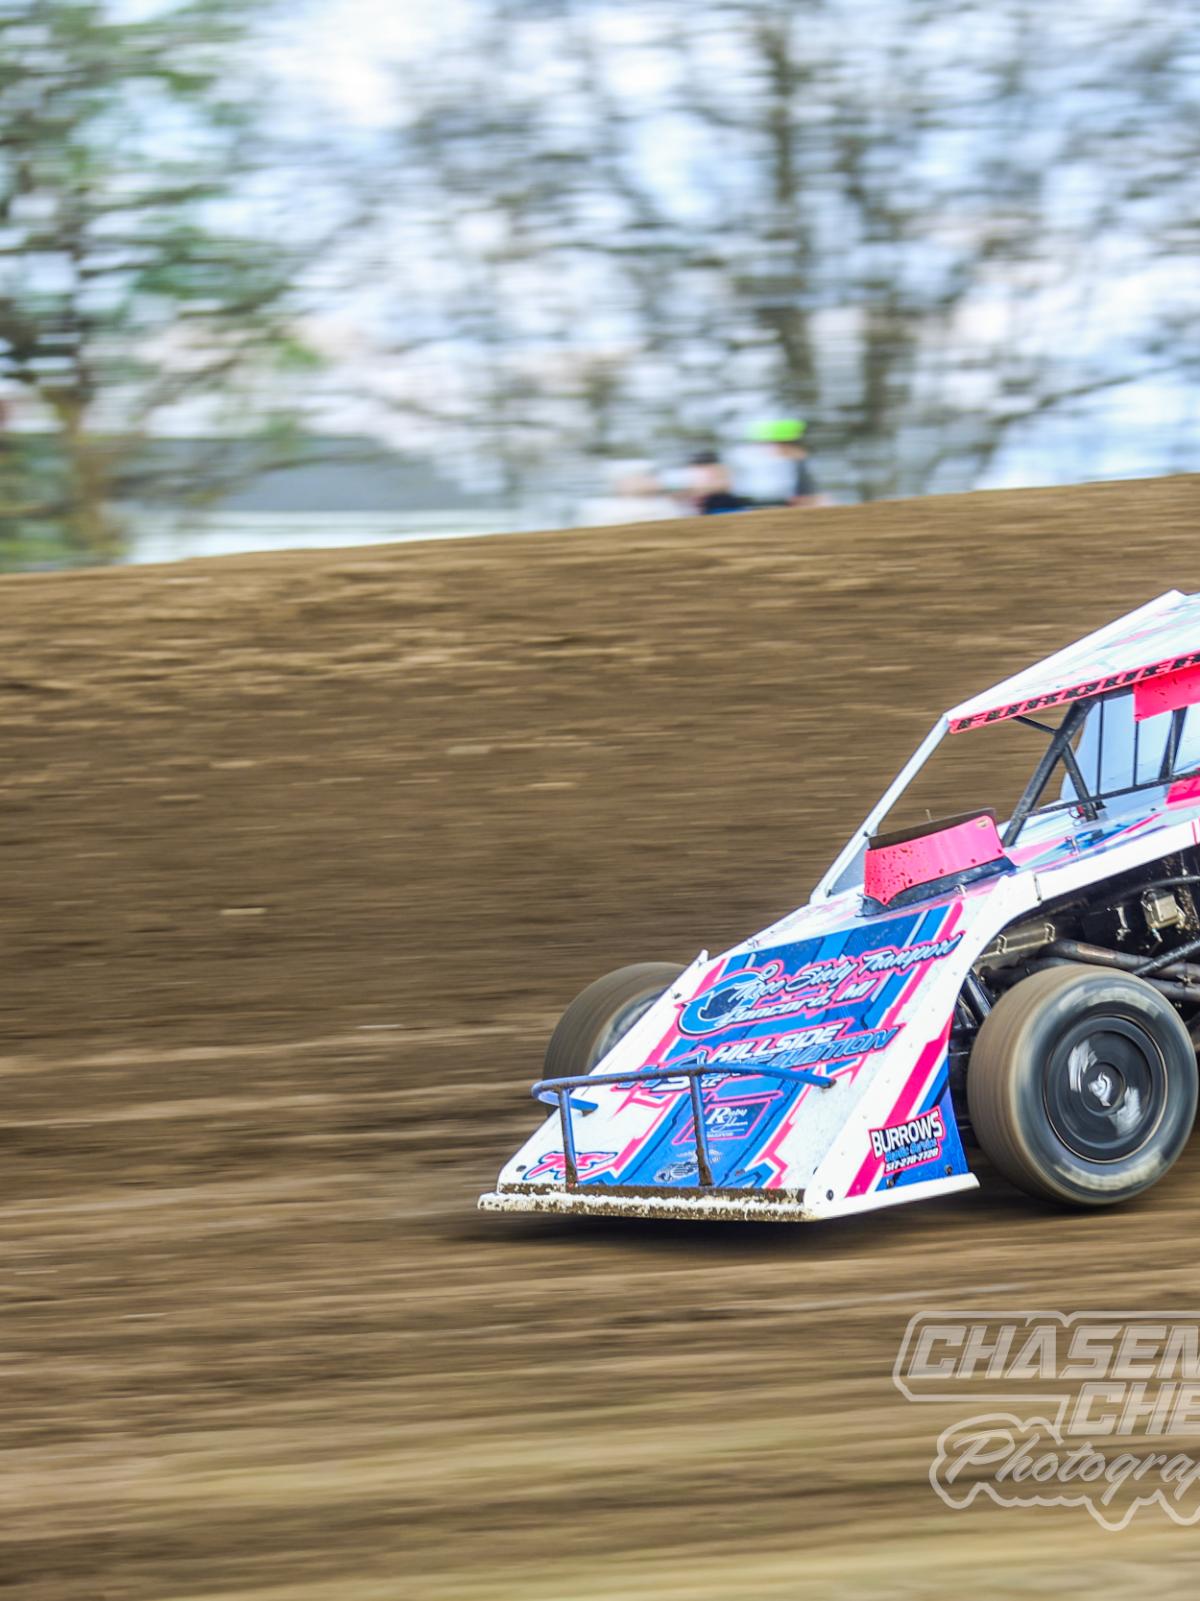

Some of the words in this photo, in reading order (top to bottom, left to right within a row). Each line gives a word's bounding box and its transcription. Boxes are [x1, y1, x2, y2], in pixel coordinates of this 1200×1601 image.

[858, 933, 963, 975] Transport
[840, 978, 877, 1002] MI
[709, 1023, 841, 1063] HILLSIDE
[871, 1110, 943, 1158] BURROWS
